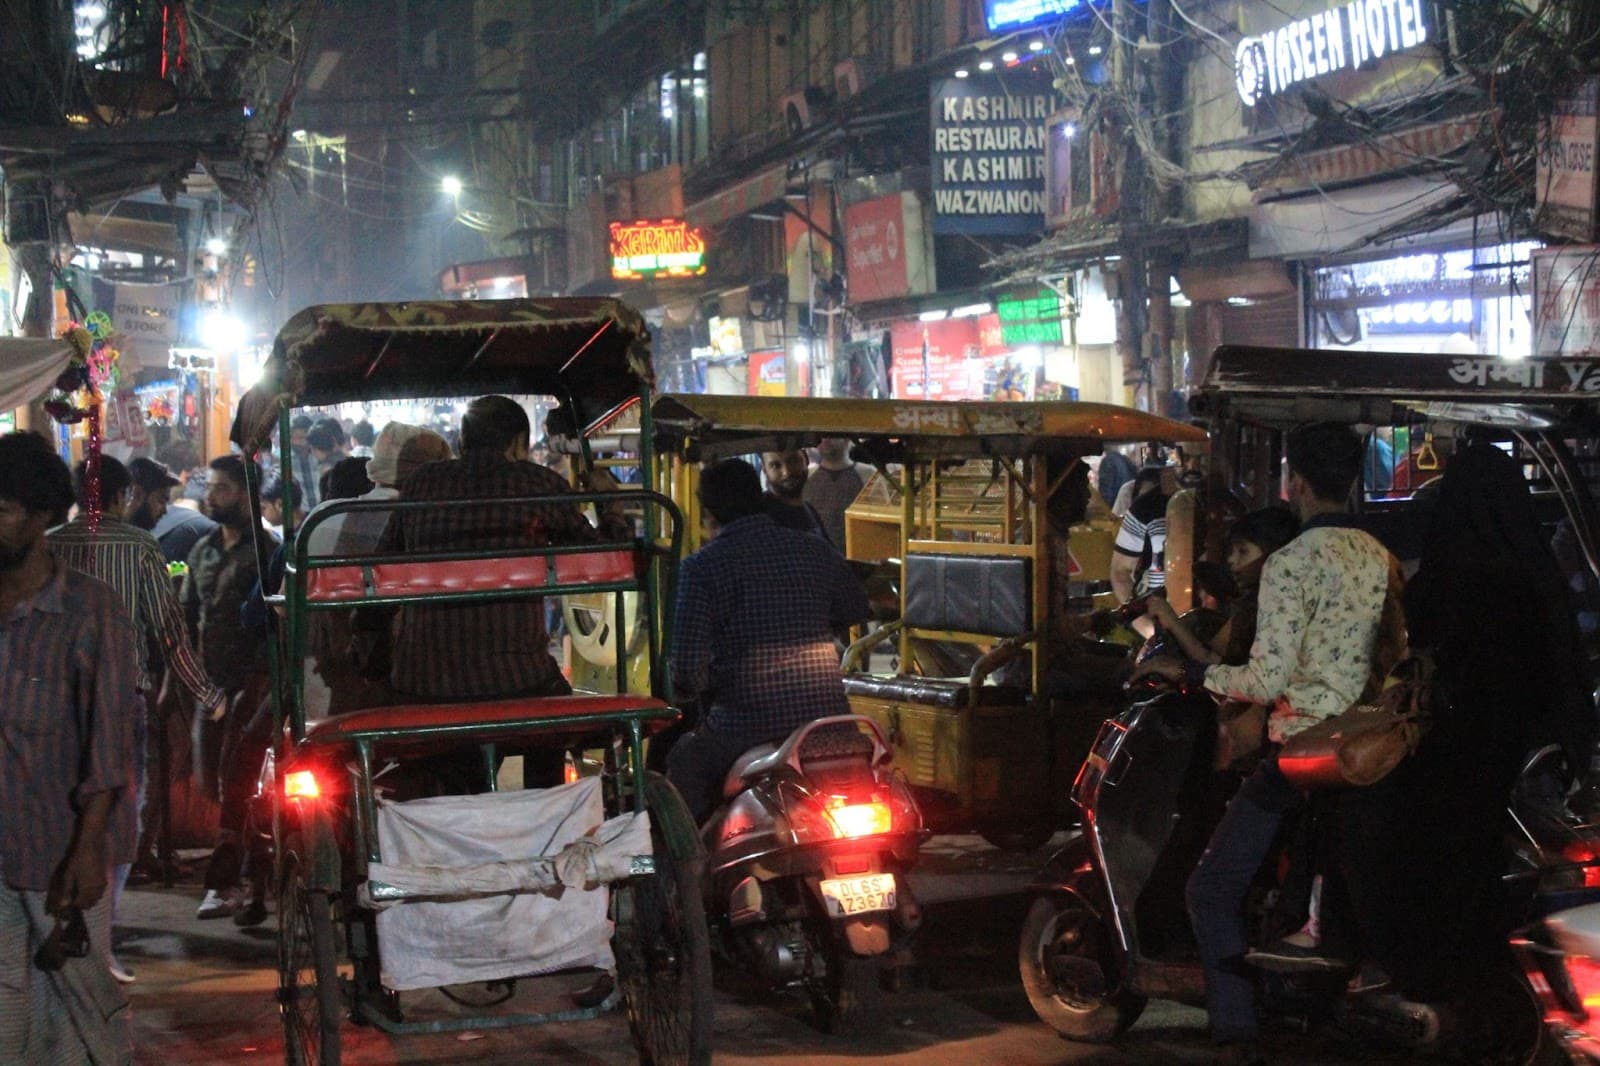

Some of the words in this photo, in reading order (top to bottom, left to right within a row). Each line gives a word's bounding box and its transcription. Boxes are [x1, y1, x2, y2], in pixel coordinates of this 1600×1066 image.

[1262, 8, 1345, 95] YASEEN
[1347, 0, 1426, 71] HOTEL
[943, 95, 1056, 121] KASHMIRI
